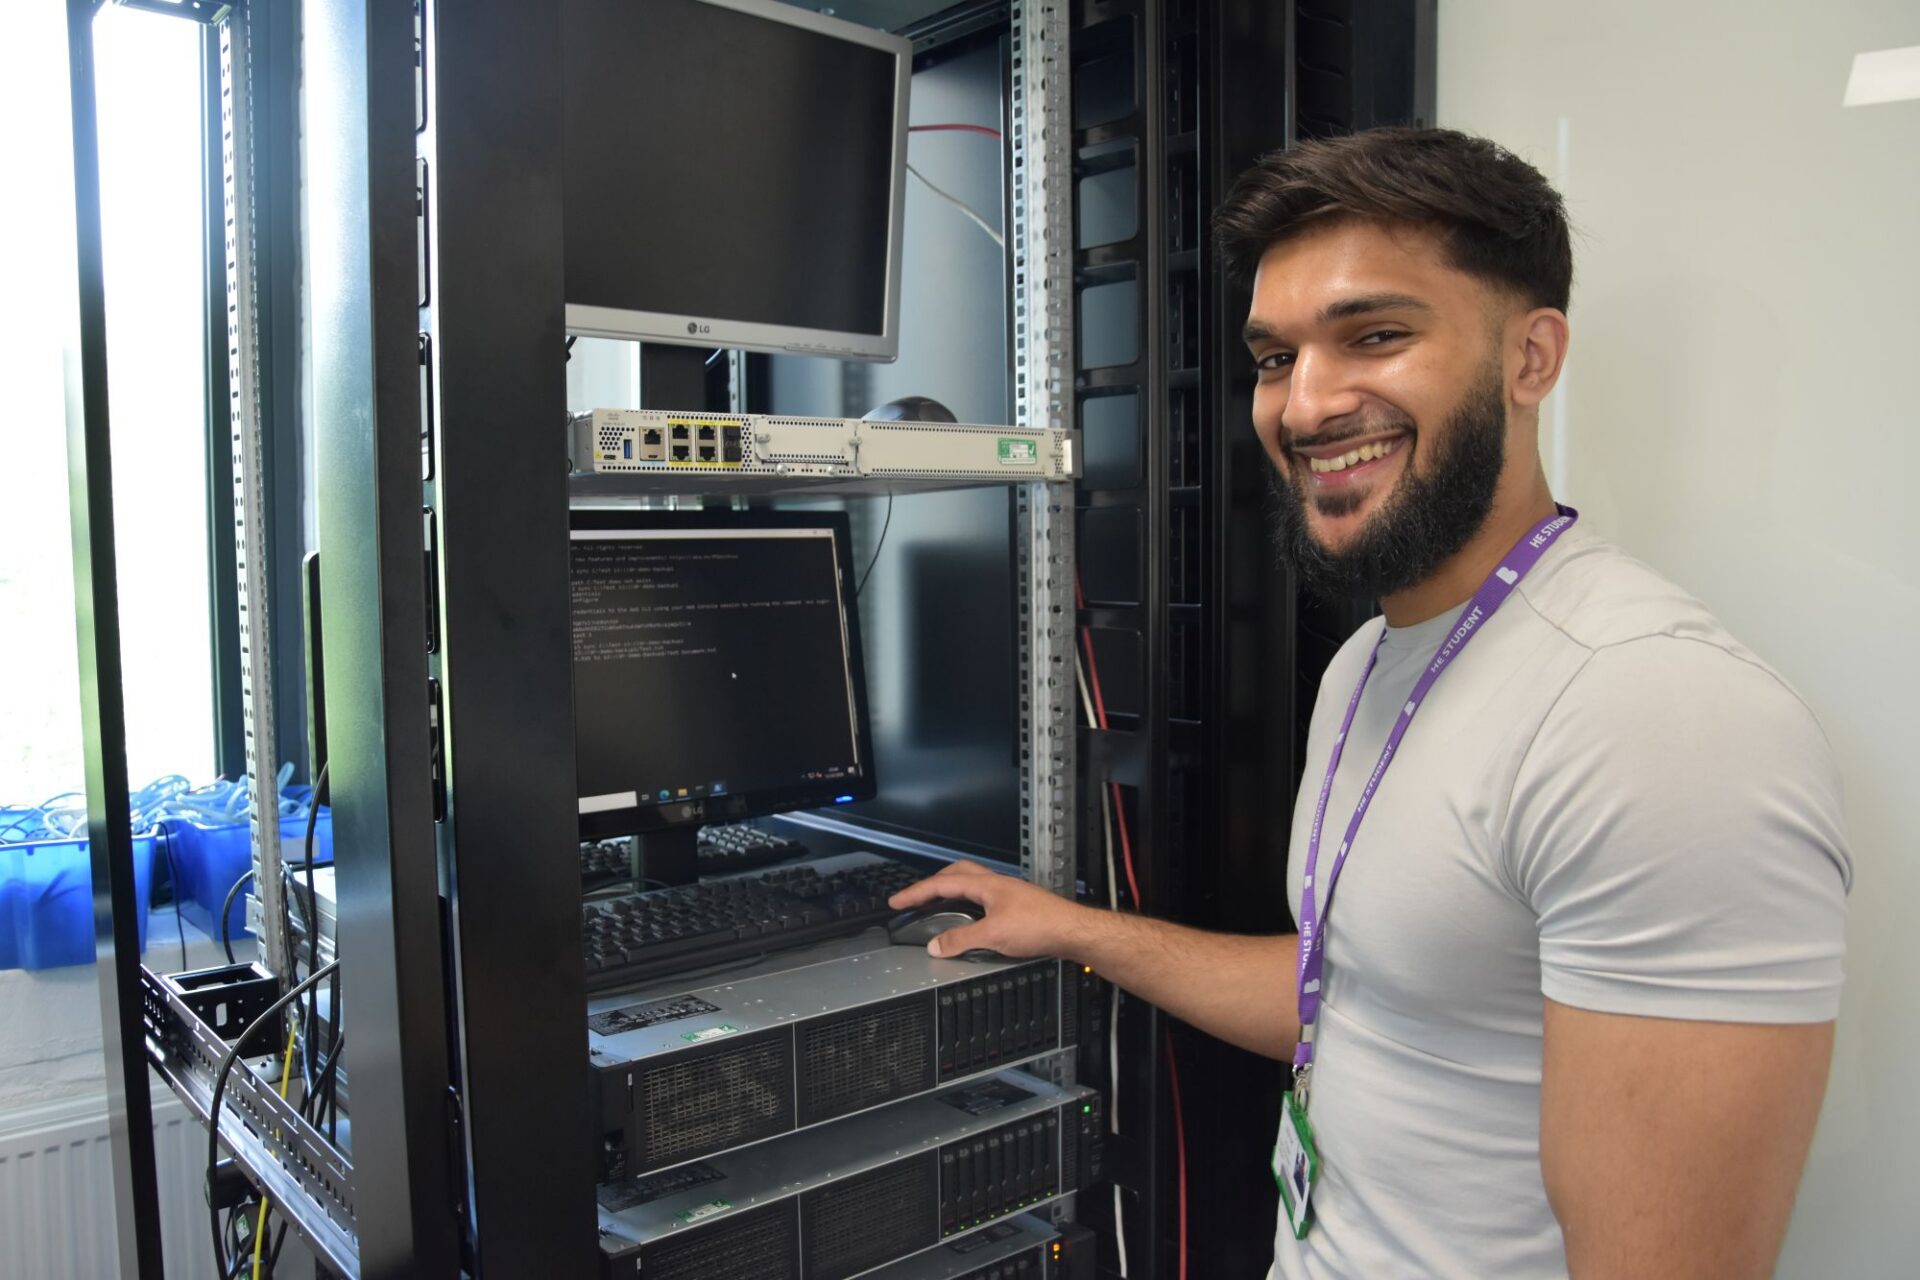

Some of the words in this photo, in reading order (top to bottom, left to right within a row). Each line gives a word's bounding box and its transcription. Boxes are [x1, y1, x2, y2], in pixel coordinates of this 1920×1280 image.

[699, 324, 710, 334] LG
[1529, 533, 1547, 549] HE
[1431, 655, 1445, 673] HE
[1442, 605, 1483, 657] STUDENT
[1303, 921, 1312, 938] HE
